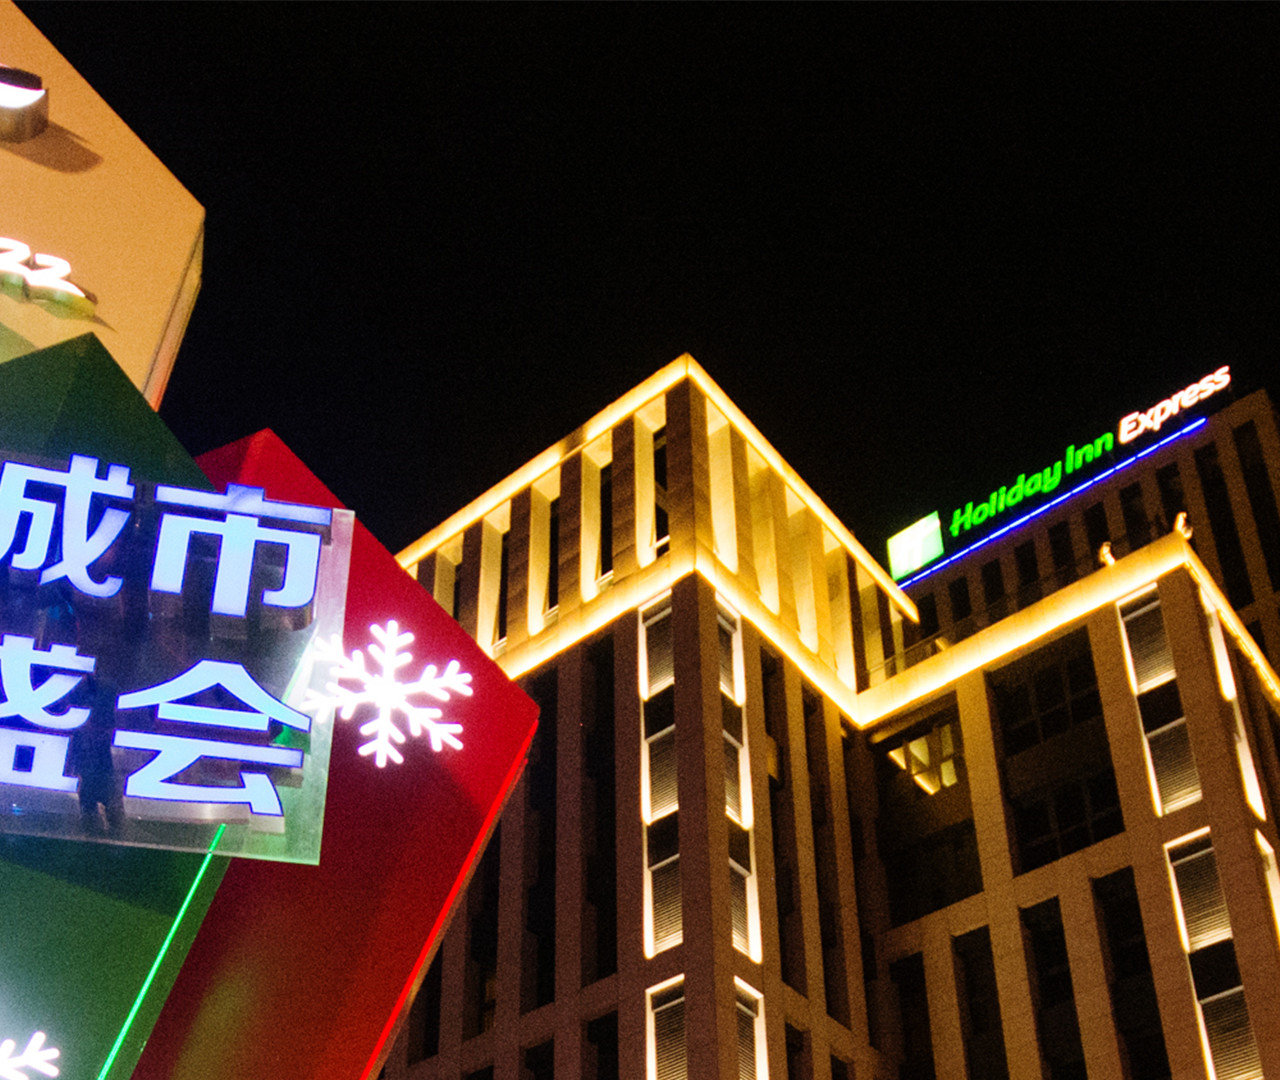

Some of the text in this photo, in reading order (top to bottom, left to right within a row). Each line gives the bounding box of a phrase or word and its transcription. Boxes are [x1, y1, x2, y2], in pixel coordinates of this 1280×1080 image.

[949, 365, 1232, 537] Holiday Inn Express
